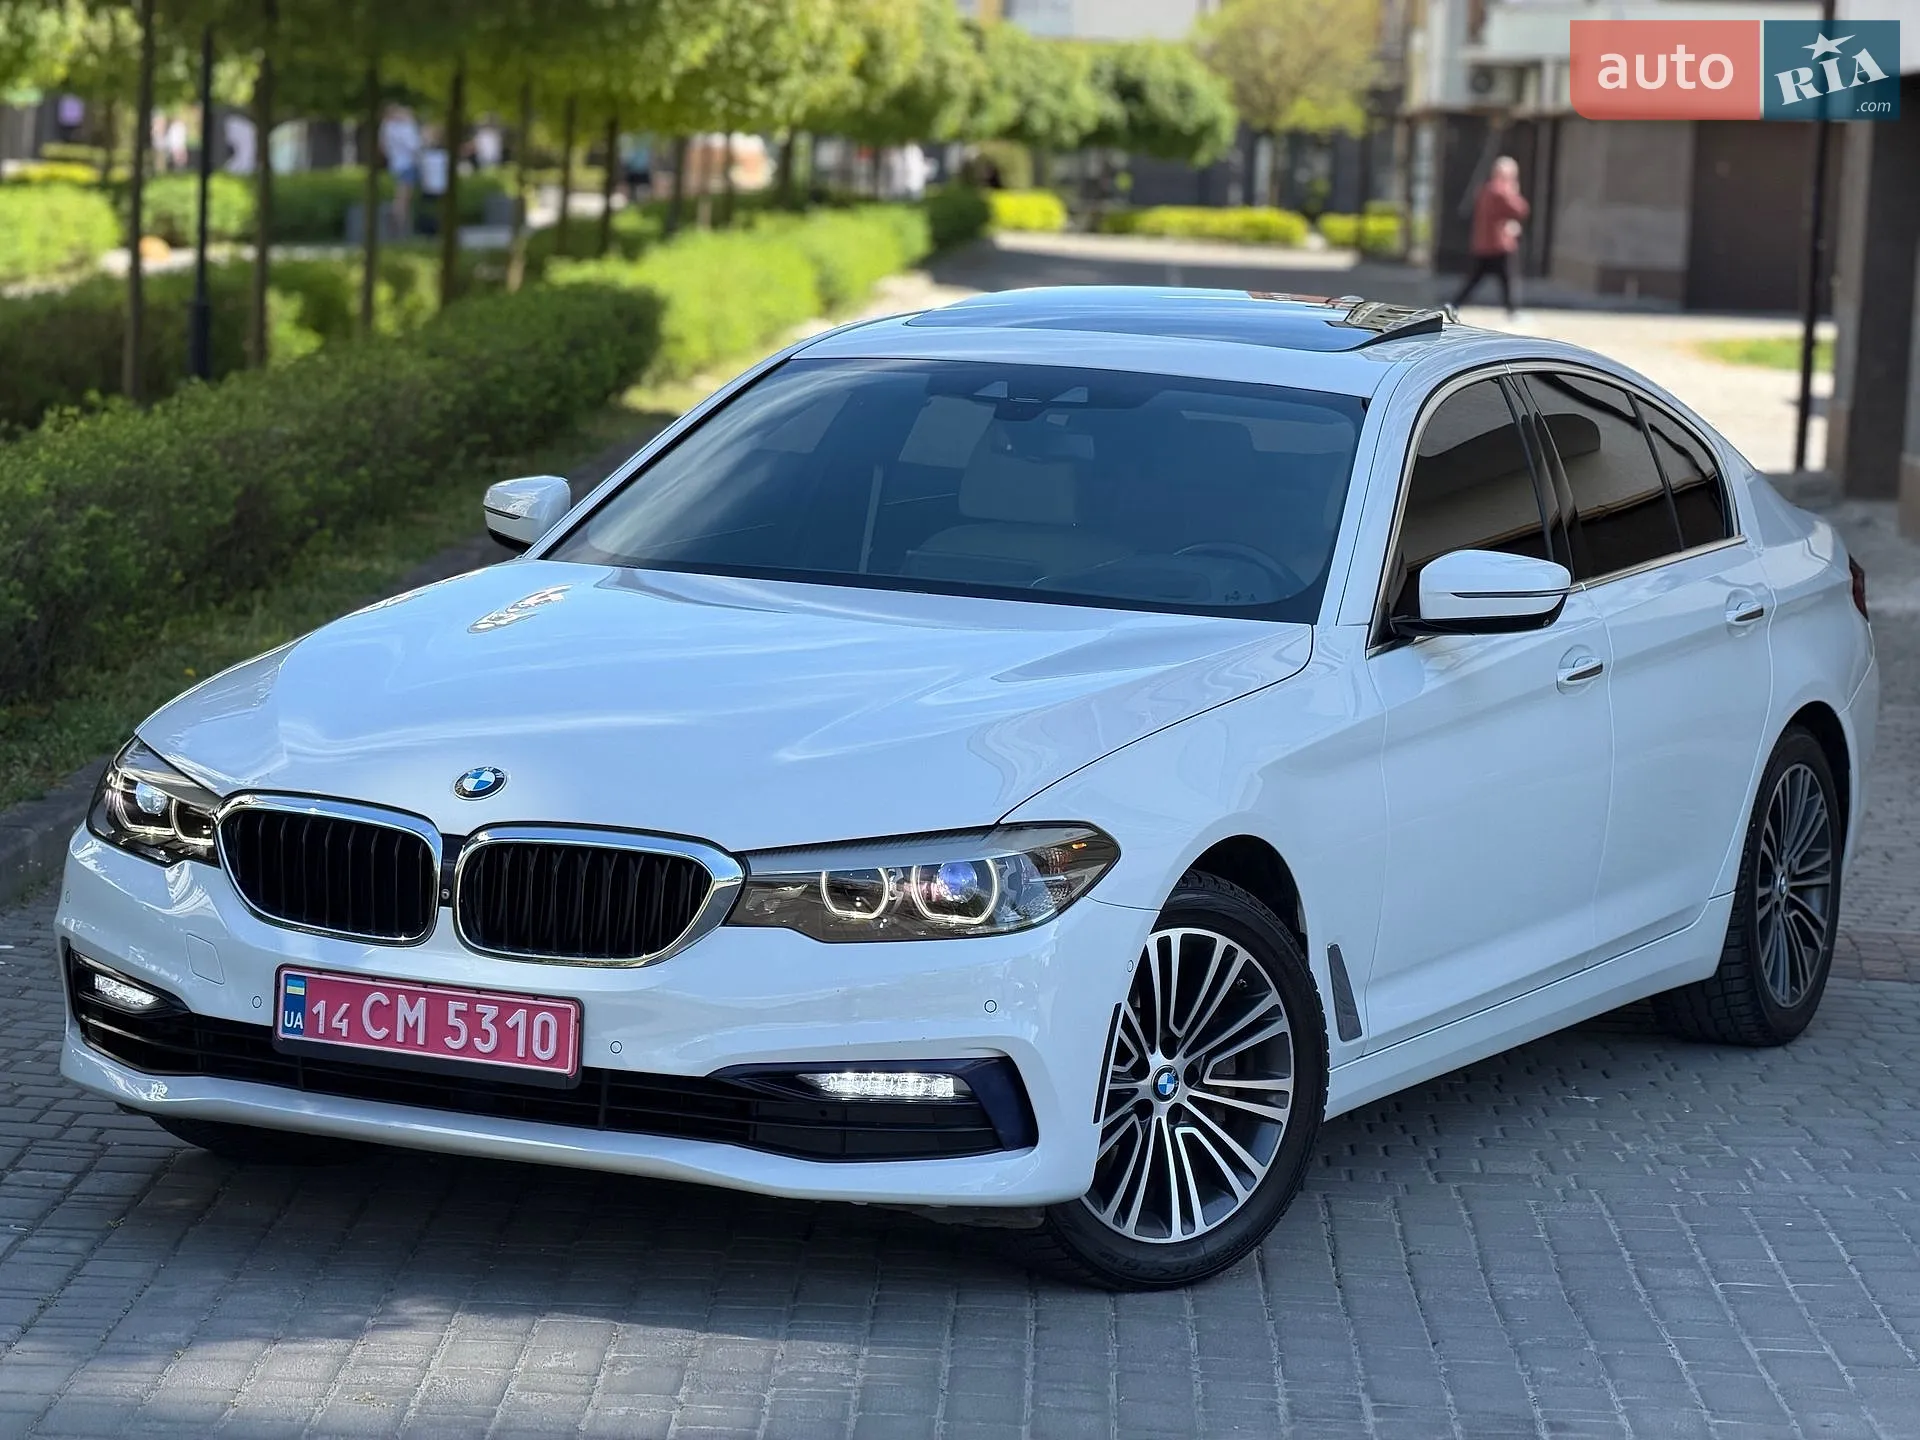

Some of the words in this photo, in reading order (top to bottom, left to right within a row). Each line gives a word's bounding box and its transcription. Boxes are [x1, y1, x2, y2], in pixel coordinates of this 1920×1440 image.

[284, 1010, 304, 1030] UA
[311, 999, 350, 1038] 14
[361, 991, 427, 1046] CM
[443, 1000, 558, 1062] 5310
